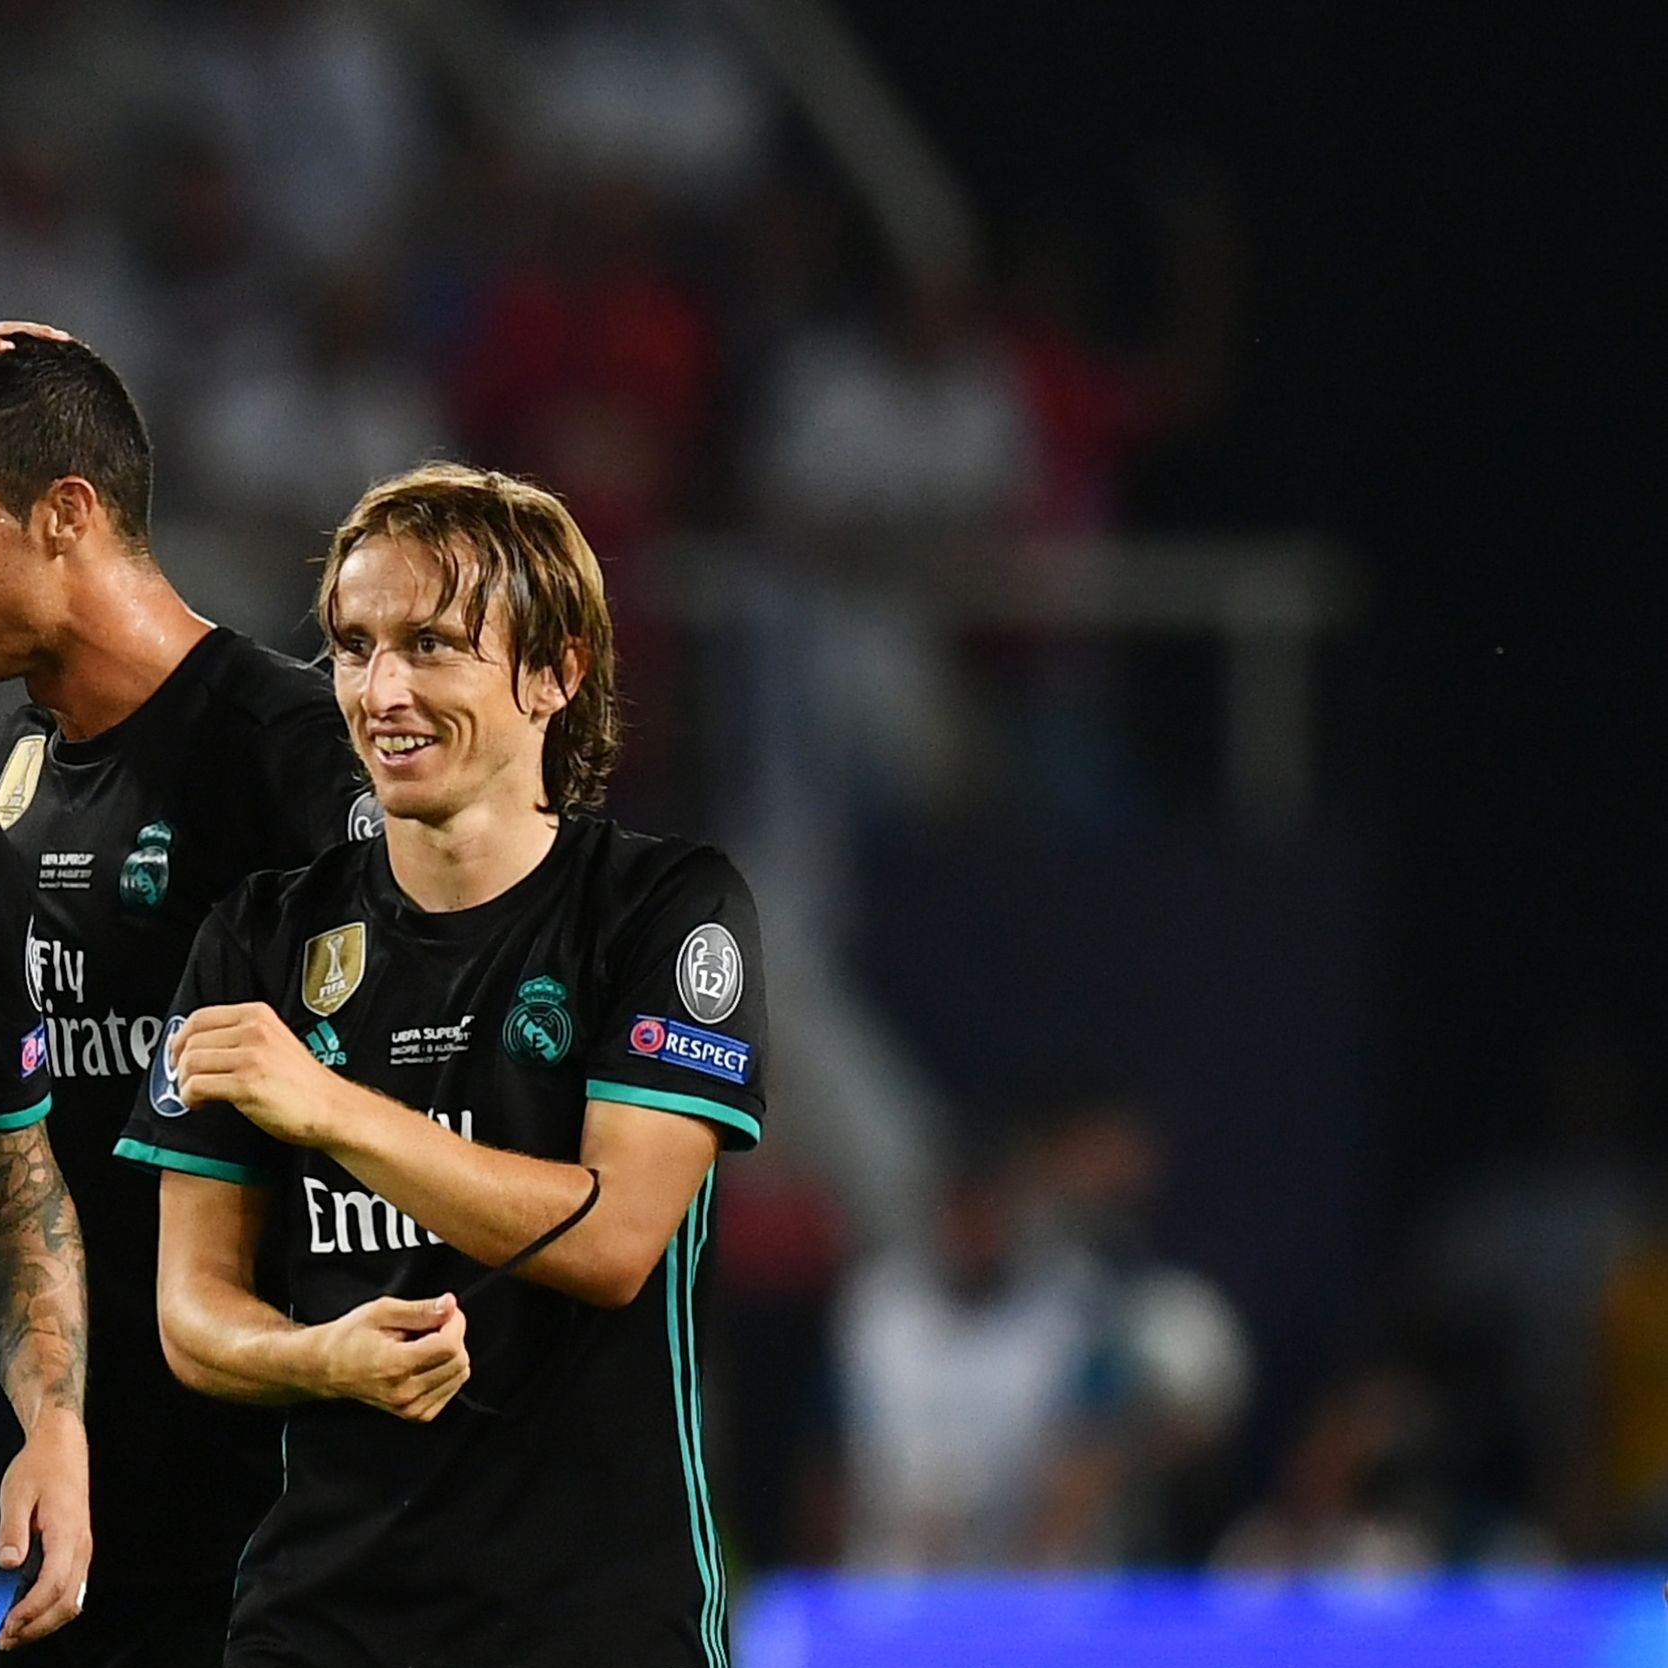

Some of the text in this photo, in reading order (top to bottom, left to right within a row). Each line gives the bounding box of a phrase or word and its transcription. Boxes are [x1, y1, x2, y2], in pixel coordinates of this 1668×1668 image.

[33, 939, 85, 1004] Fly
[695, 968, 724, 1000] 12
[44, 998, 165, 1078] irate
[391, 1028, 421, 1044] UEFA
[666, 1032, 749, 1074] RESPECT
